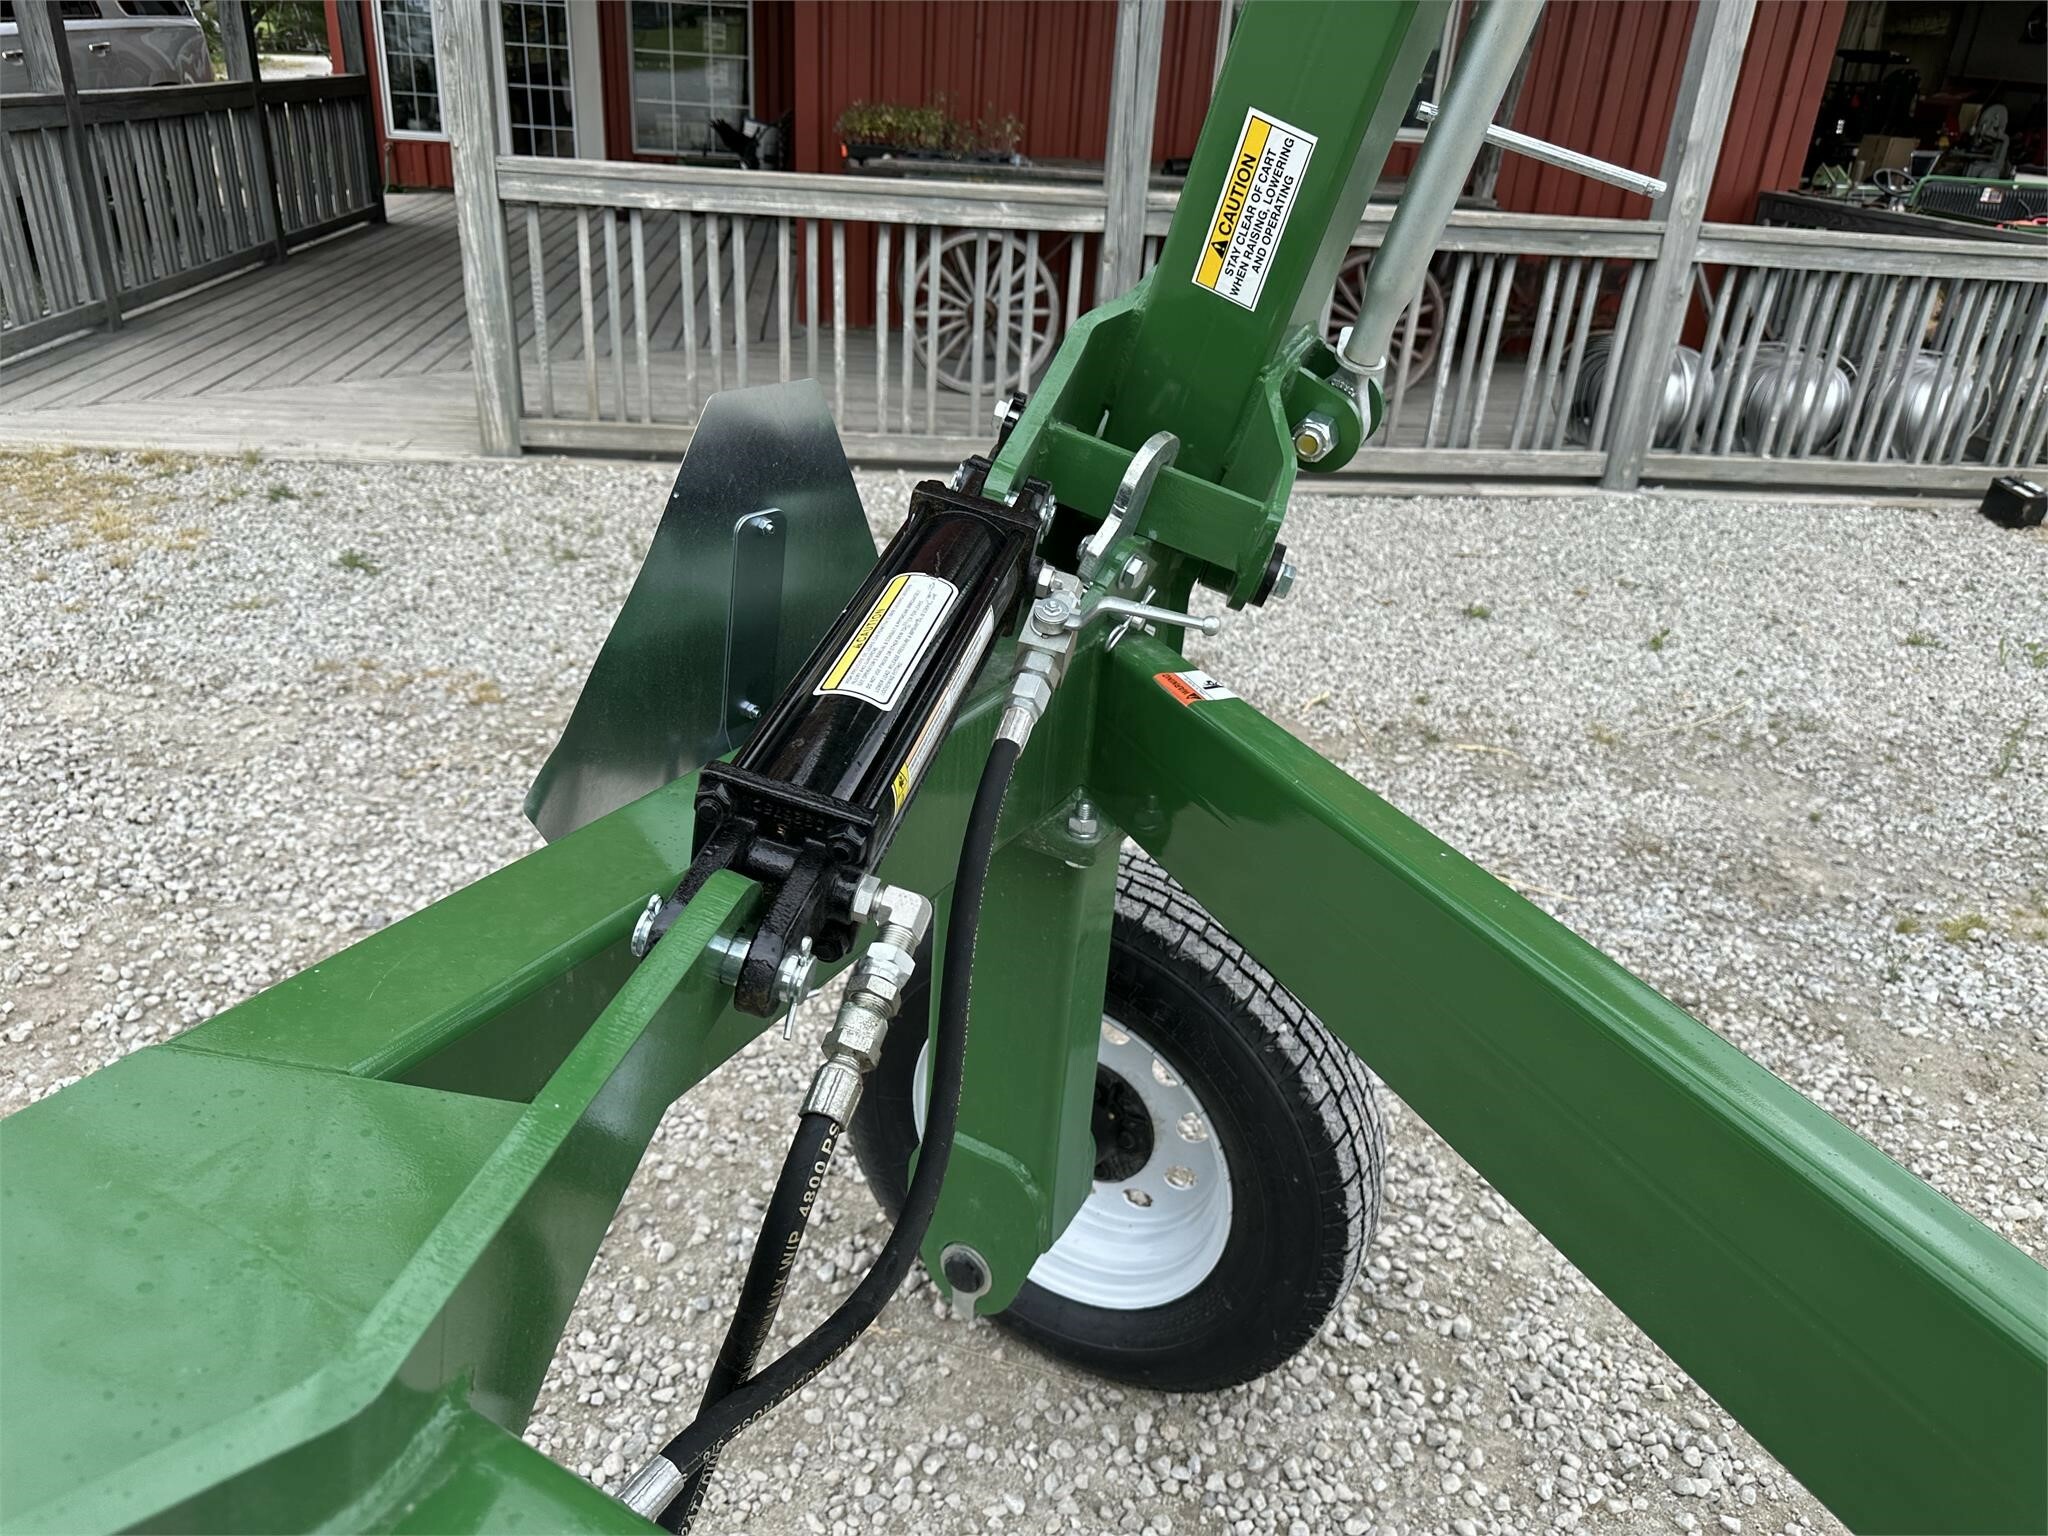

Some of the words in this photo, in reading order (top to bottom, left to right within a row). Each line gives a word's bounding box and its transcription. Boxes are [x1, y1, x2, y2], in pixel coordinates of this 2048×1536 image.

[1218, 153, 1257, 236] CAUTION
[1224, 247, 1241, 277] STAY
[1237, 207, 1257, 246] CLEAR
[1251, 186, 1263, 204] OF
[1258, 148, 1277, 183] CART
[1229, 261, 1249, 296] WHEN
[1244, 209, 1271, 259] RAISING,
[1266, 137, 1295, 207] LOWERING
[1252, 248, 1267, 274] AND
[1262, 175, 1294, 245] OPERATING
[856, 607, 885, 645] CAUTION
[799, 1160, 827, 1218] 4800
[821, 1122, 840, 1155] PS
